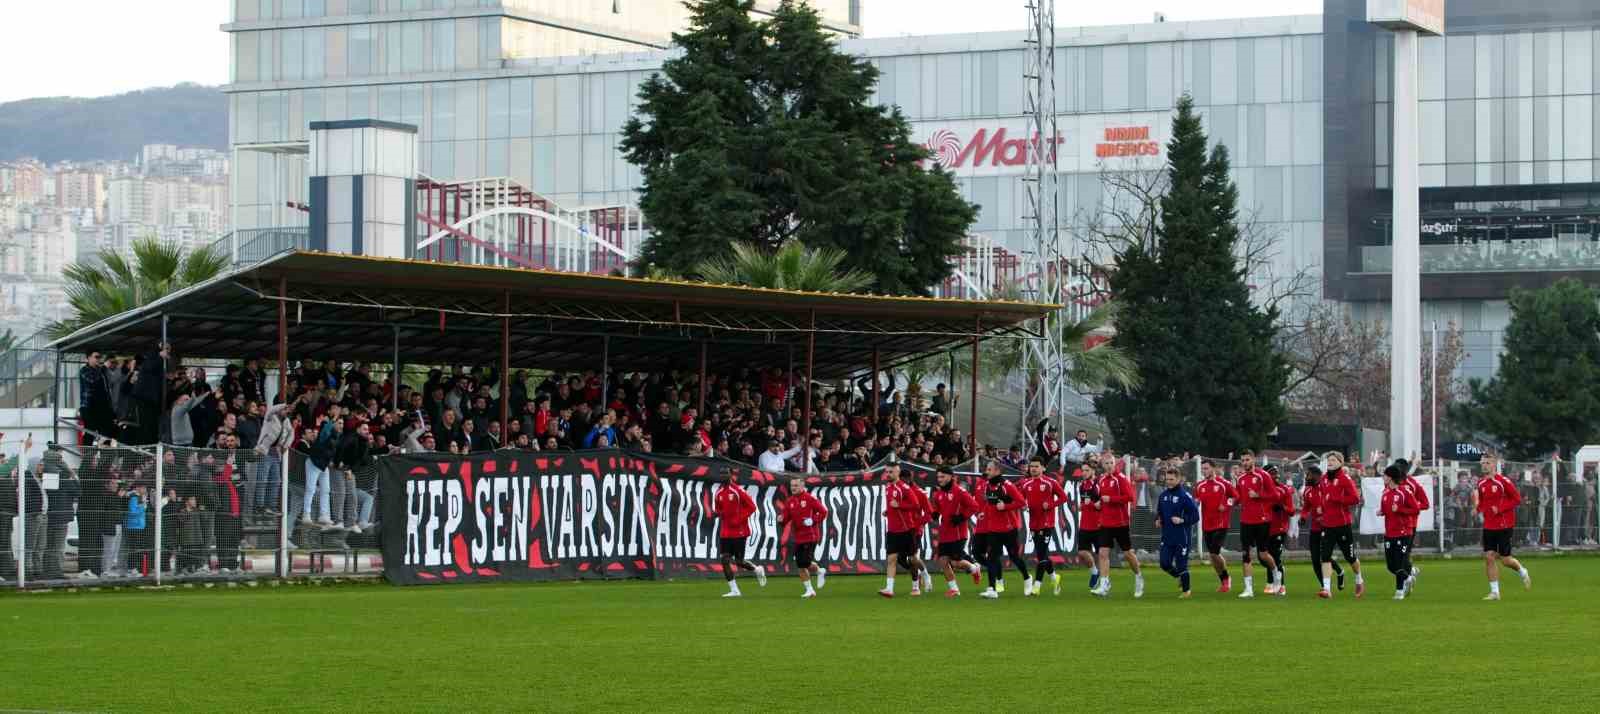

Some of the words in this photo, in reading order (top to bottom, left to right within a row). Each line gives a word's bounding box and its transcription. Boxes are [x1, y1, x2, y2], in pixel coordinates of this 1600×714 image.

[404, 479, 463, 566] HEP
[471, 476, 530, 564] SEN
[656, 478, 778, 560] AKLIDA
